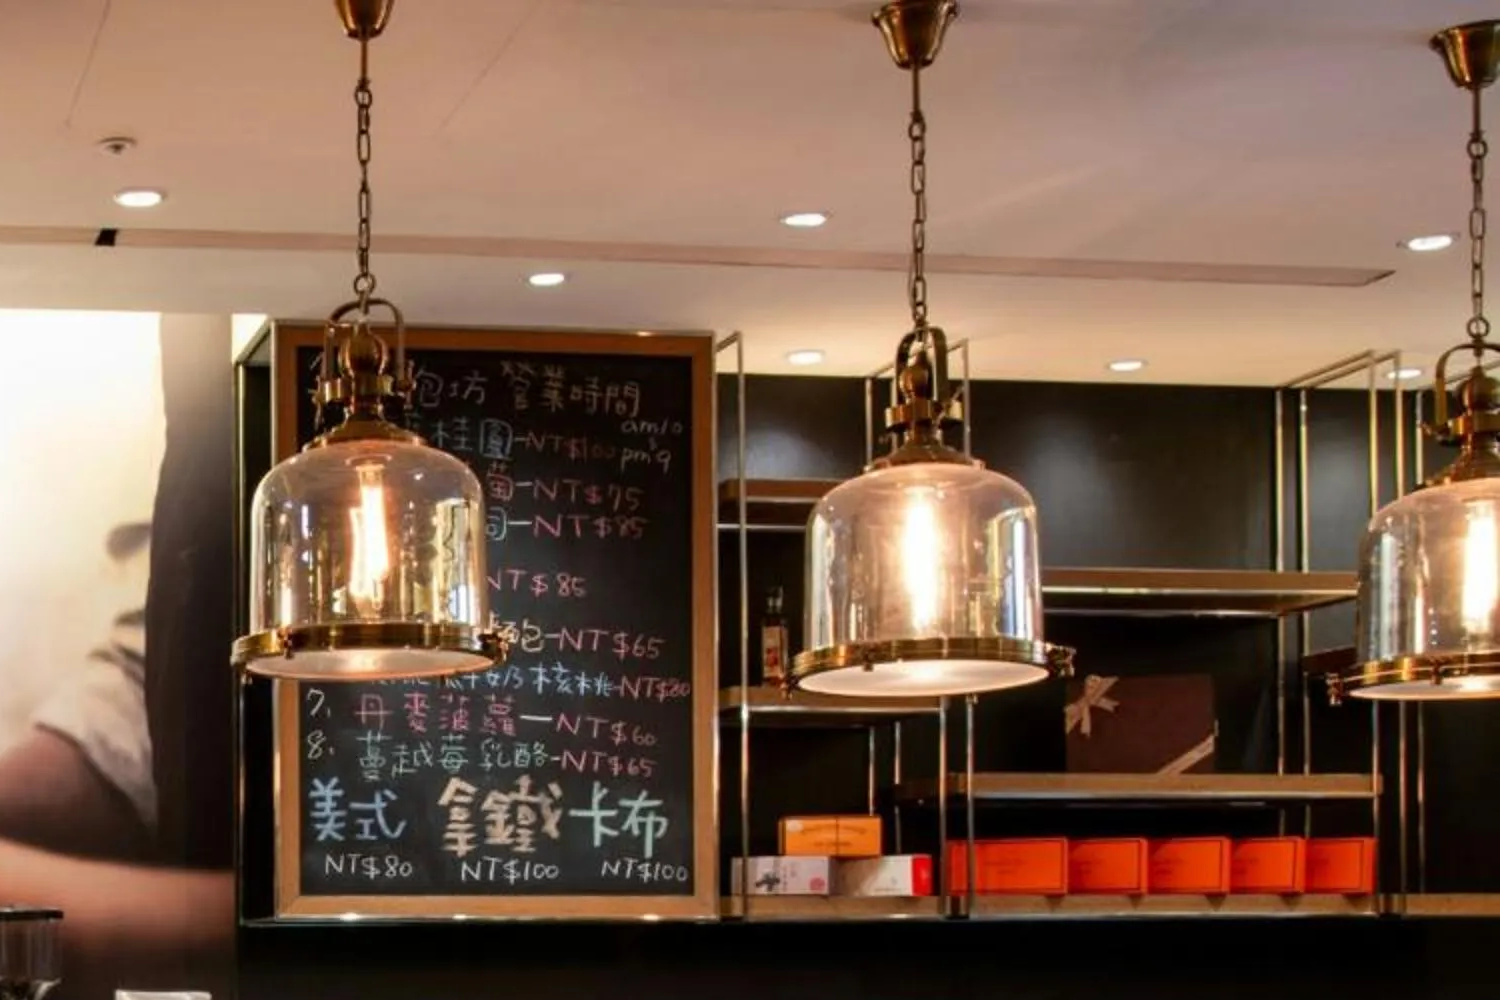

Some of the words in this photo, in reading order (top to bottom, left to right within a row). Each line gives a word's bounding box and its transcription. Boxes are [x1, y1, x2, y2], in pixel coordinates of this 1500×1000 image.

[308, 776, 408, 842] 美式
[568, 780, 669, 859] 卡布
[325, 853, 414, 880] NT$80
[461, 856, 560, 885] NT$100
[601, 857, 689, 884] NT$100
